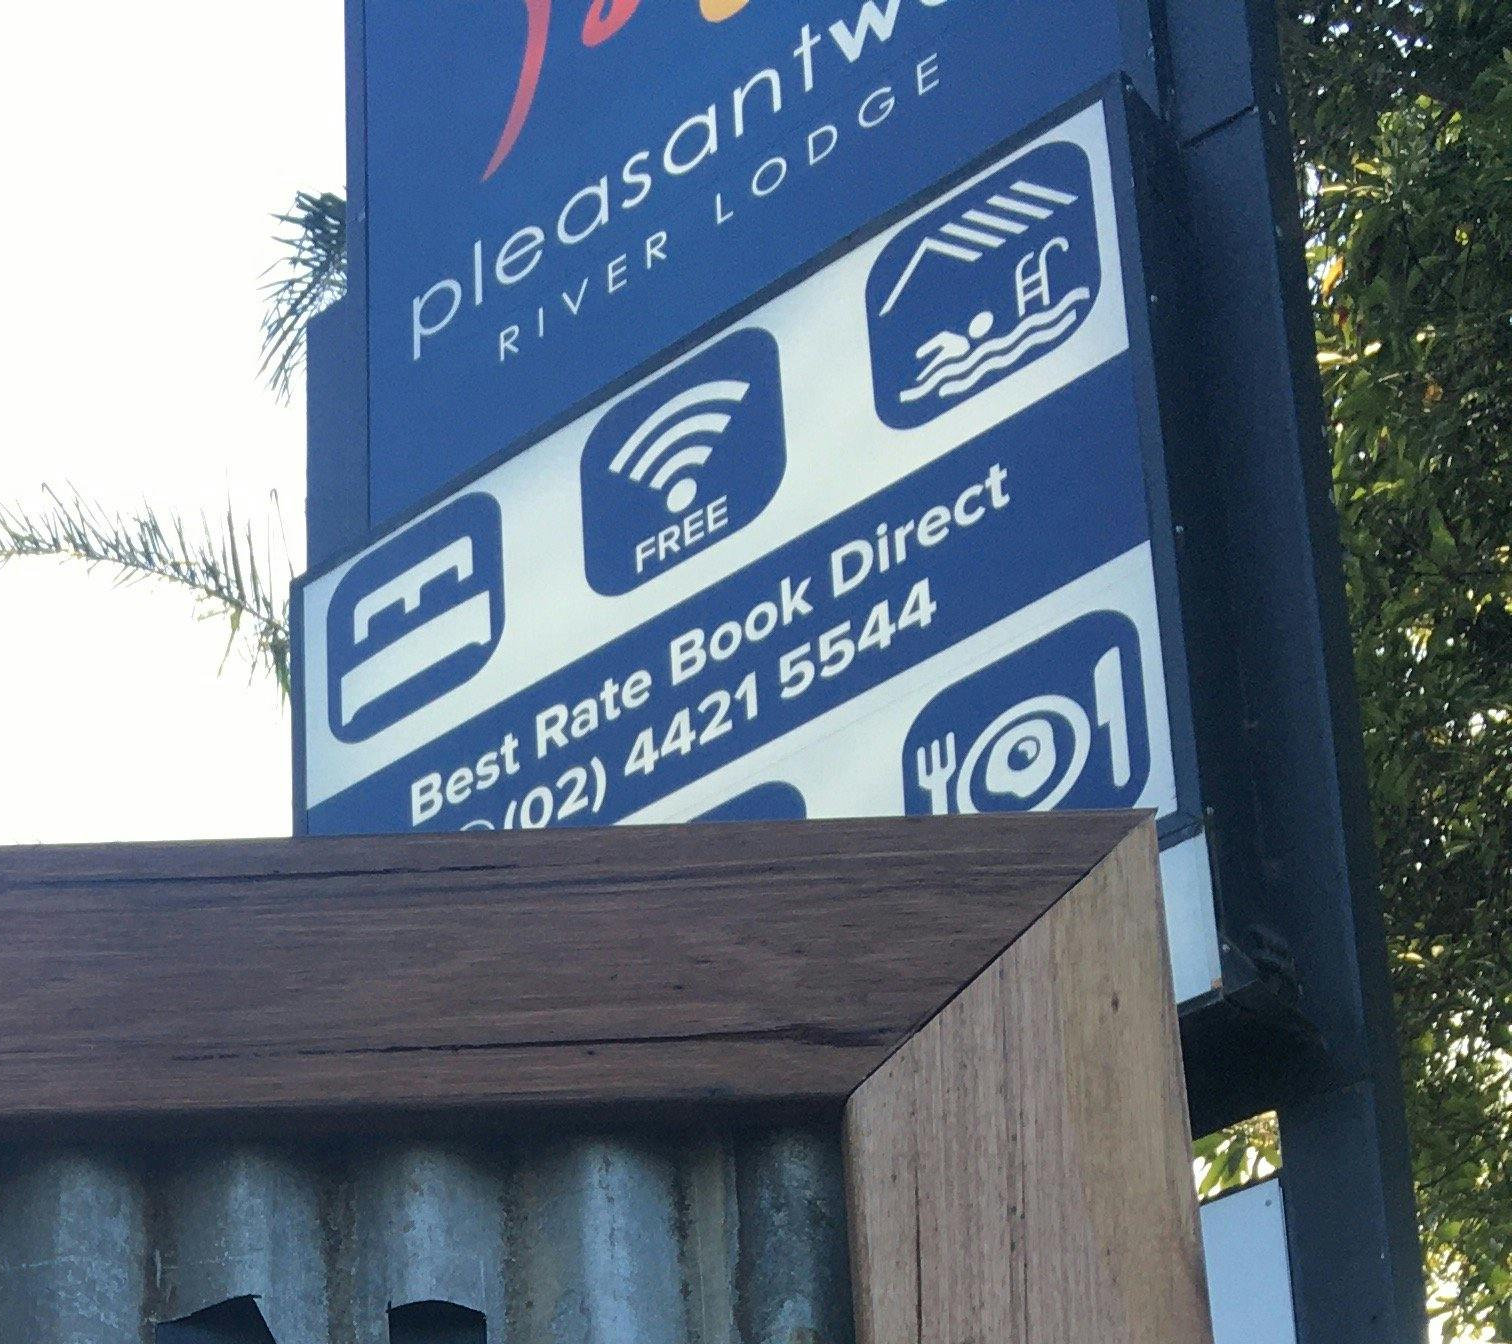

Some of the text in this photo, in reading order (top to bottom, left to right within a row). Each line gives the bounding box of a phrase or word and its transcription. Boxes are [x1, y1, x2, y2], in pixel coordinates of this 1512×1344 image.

[412, 0, 948, 361] pleasantw
[498, 52, 940, 362] RIVER LODGE
[411, 463, 1011, 828] Best Rate Book Direct
[624, 671, 758, 777] 4421
[778, 577, 937, 699] 5544
[635, 495, 730, 574] FREE
